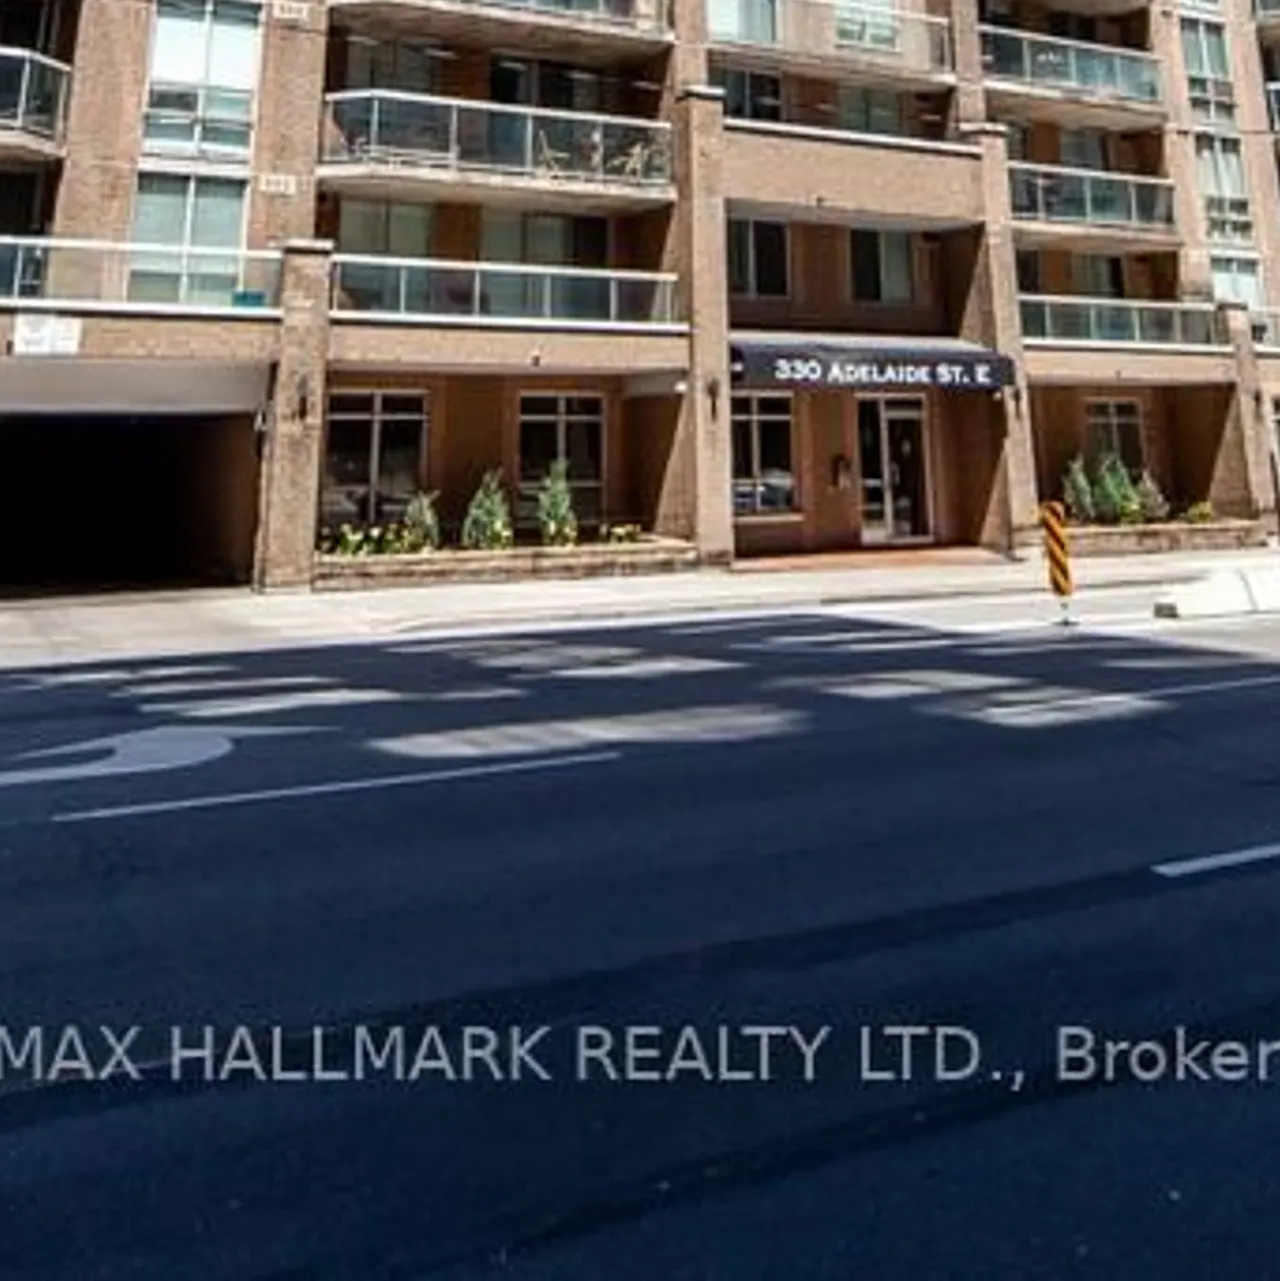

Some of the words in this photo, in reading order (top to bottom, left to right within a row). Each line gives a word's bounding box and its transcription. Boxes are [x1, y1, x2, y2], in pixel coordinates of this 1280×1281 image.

[774, 358, 821, 381] 330
[827, 361, 930, 384] ADELAIDE
[935, 362, 970, 385] ST.
